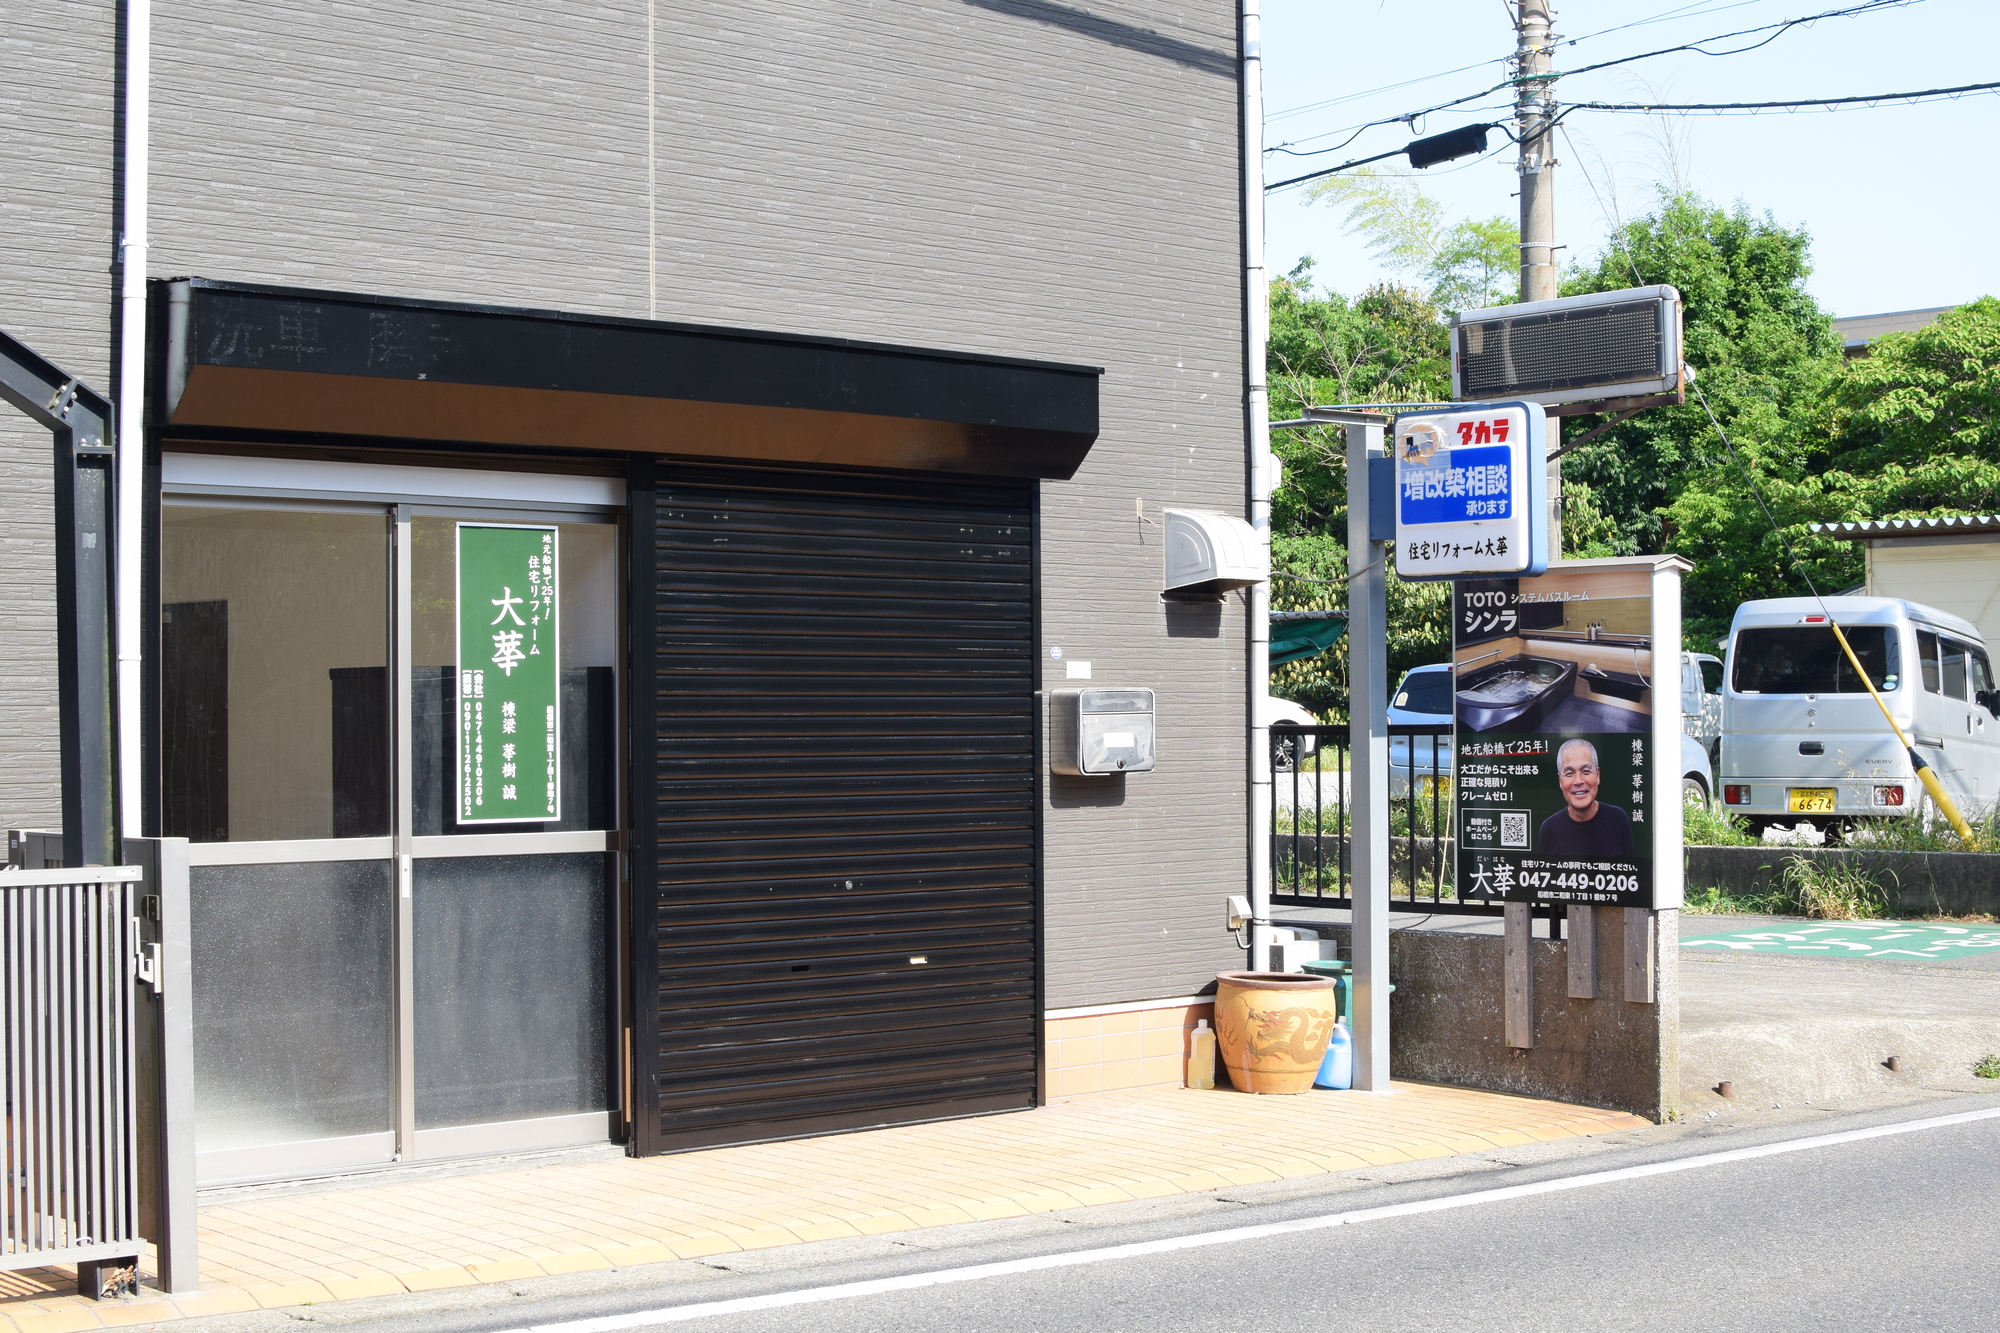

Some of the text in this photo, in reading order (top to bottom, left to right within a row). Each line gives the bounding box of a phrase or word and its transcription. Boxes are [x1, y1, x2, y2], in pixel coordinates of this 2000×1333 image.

[1456, 419, 1510, 445] タカラ
[1404, 464, 1509, 501] 増改築相談
[1466, 499, 1509, 516] 承ります
[1408, 536, 1509, 560] 住宅リフォーム大華
[528, 555, 541, 655] 住宅リフォーム
[1464, 591, 1590, 608] TOTO システムバスルーム
[491, 586, 527, 676] 大華
[1465, 610, 1517, 633] シンラ
[1461, 764, 1538, 775] 大工だからこそ出来る
[1461, 777, 1506, 788] 正確な見積り
[1799, 799, 1832, 810] 66-74
[1469, 863, 1516, 897] 大華
[1519, 871, 1639, 892] 047-449-0206
